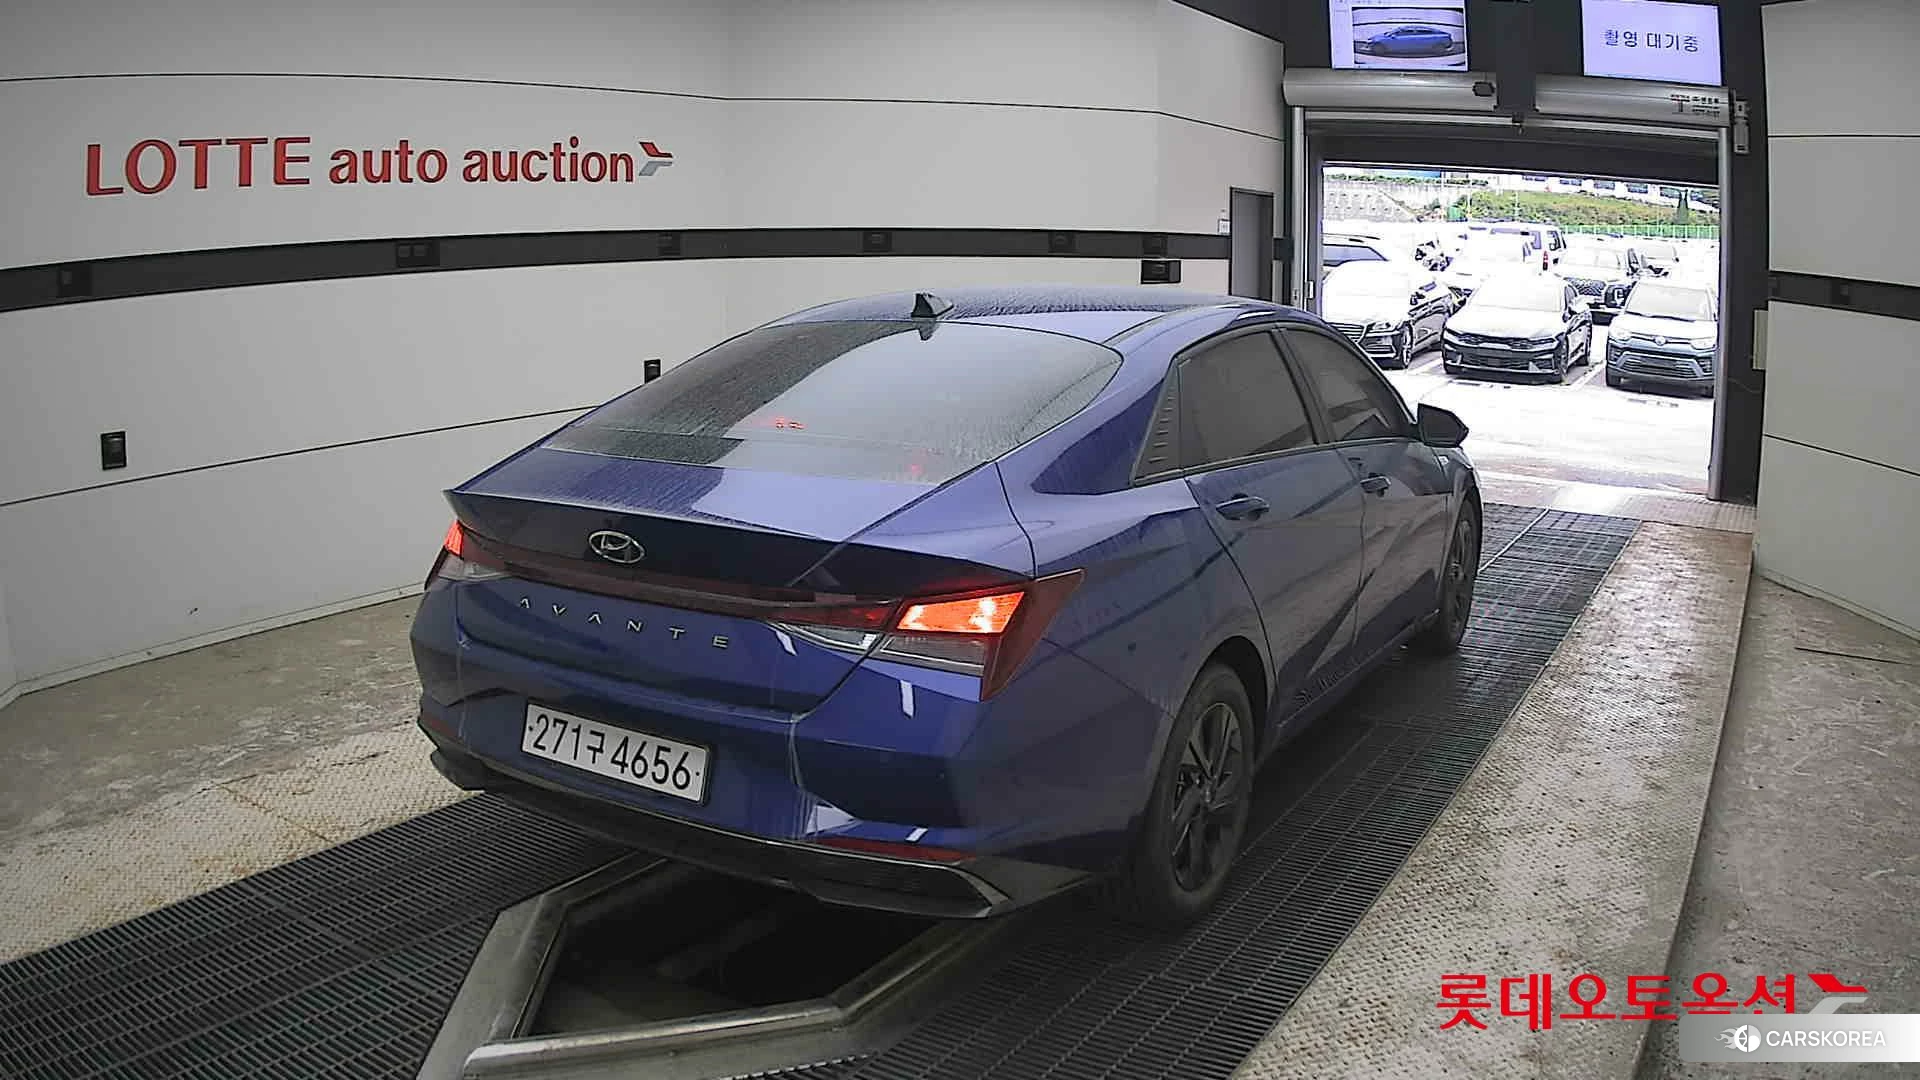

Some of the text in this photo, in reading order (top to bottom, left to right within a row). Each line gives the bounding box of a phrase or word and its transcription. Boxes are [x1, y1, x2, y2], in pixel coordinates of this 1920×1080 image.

[1646, 32, 1699, 53] 대기중
[86, 136, 634, 196] LOTTE auto auction
[518, 597, 729, 649] AVANTE
